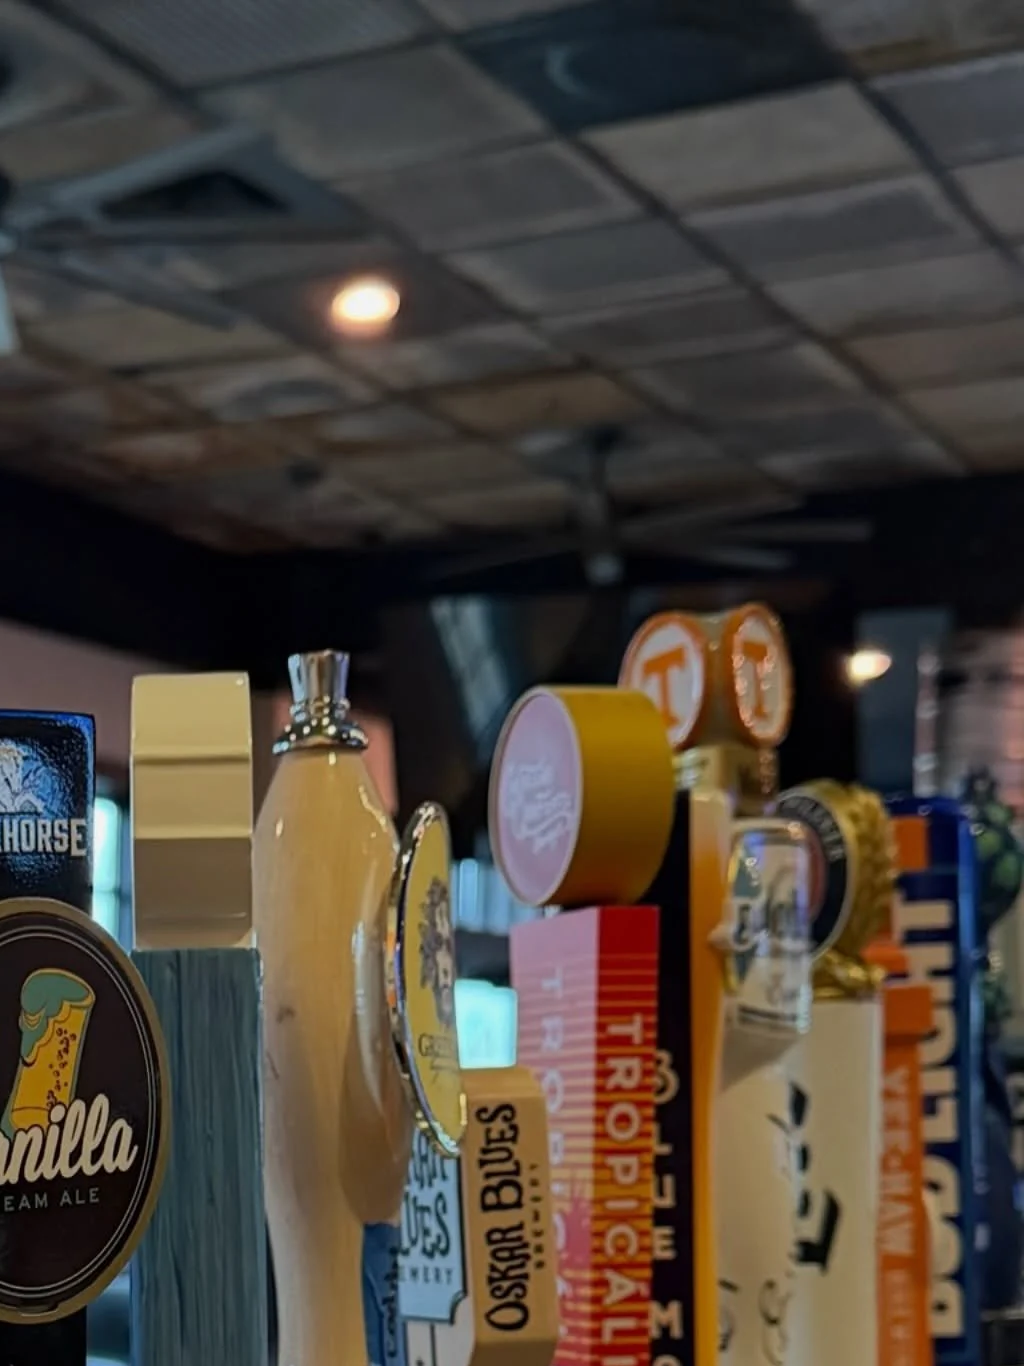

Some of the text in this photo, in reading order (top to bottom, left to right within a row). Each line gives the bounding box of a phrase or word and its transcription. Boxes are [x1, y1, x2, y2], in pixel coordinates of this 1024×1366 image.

[59, 1187, 101, 1206] ALE
[400, 1191, 450, 1258] UES
[476, 1102, 530, 1333] OSKAR BLUES
